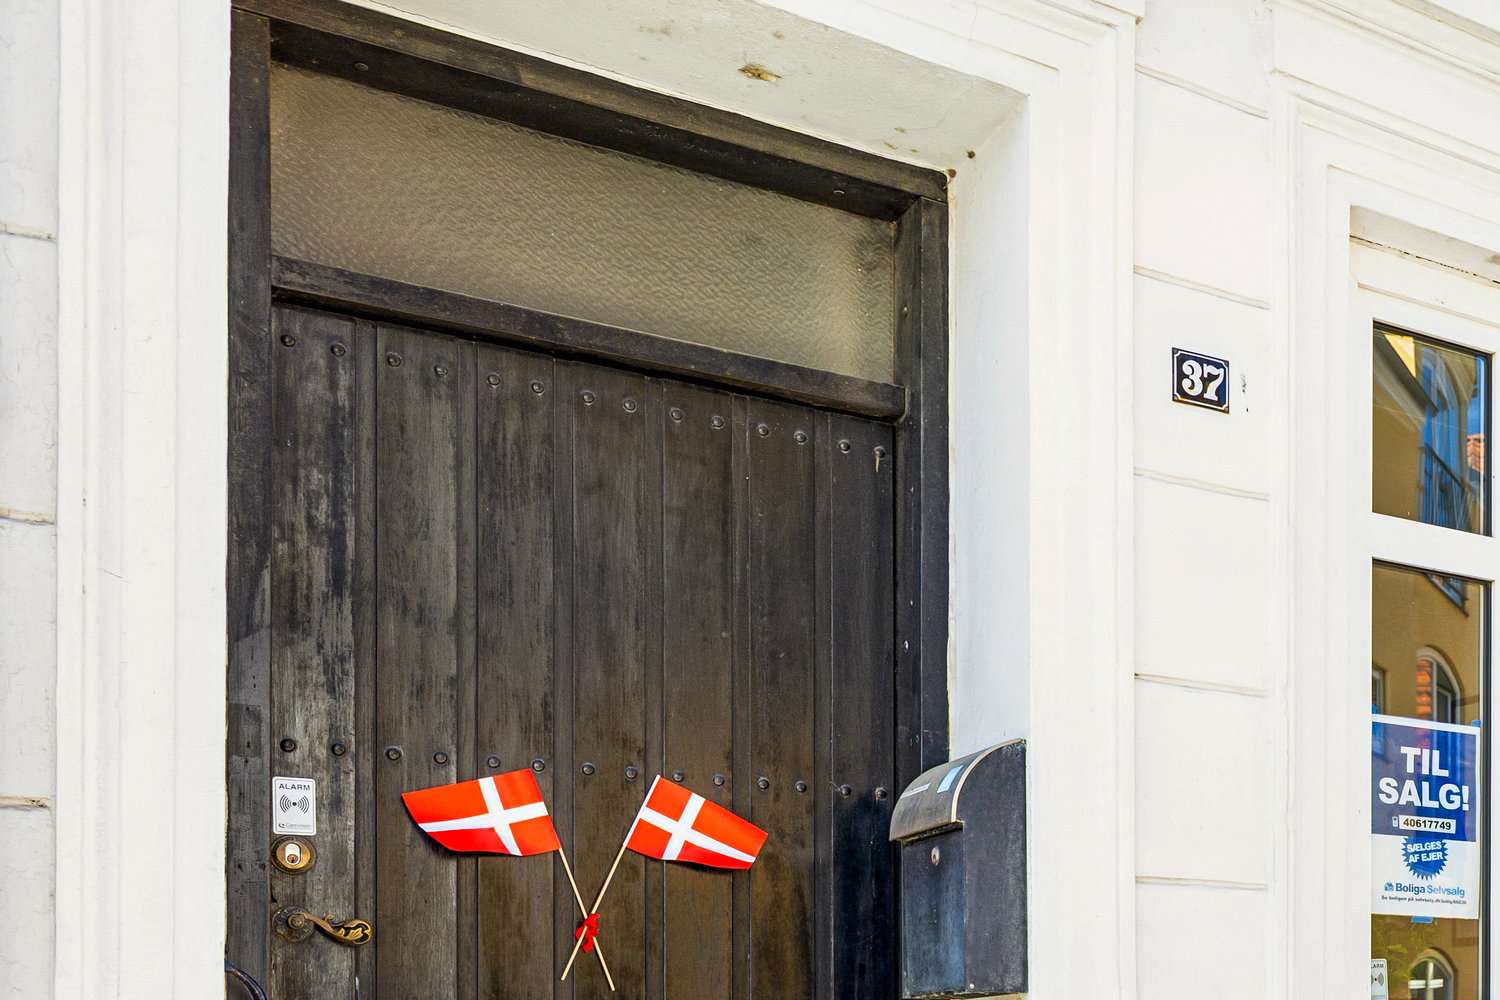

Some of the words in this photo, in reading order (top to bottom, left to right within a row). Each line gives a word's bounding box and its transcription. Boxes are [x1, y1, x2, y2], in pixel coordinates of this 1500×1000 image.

[1182, 359, 1224, 401] 37
[1400, 746, 1449, 777] TIL
[1378, 777, 1469, 811] SALG!
[1403, 818, 1451, 831] 40617749
[1406, 841, 1442, 853] SÆLGES
[1408, 853, 1420, 863] AF
[1421, 852, 1443, 862] EJER
[1395, 882, 1426, 895] Boliga
[1427, 884, 1465, 899] Selvsalg
